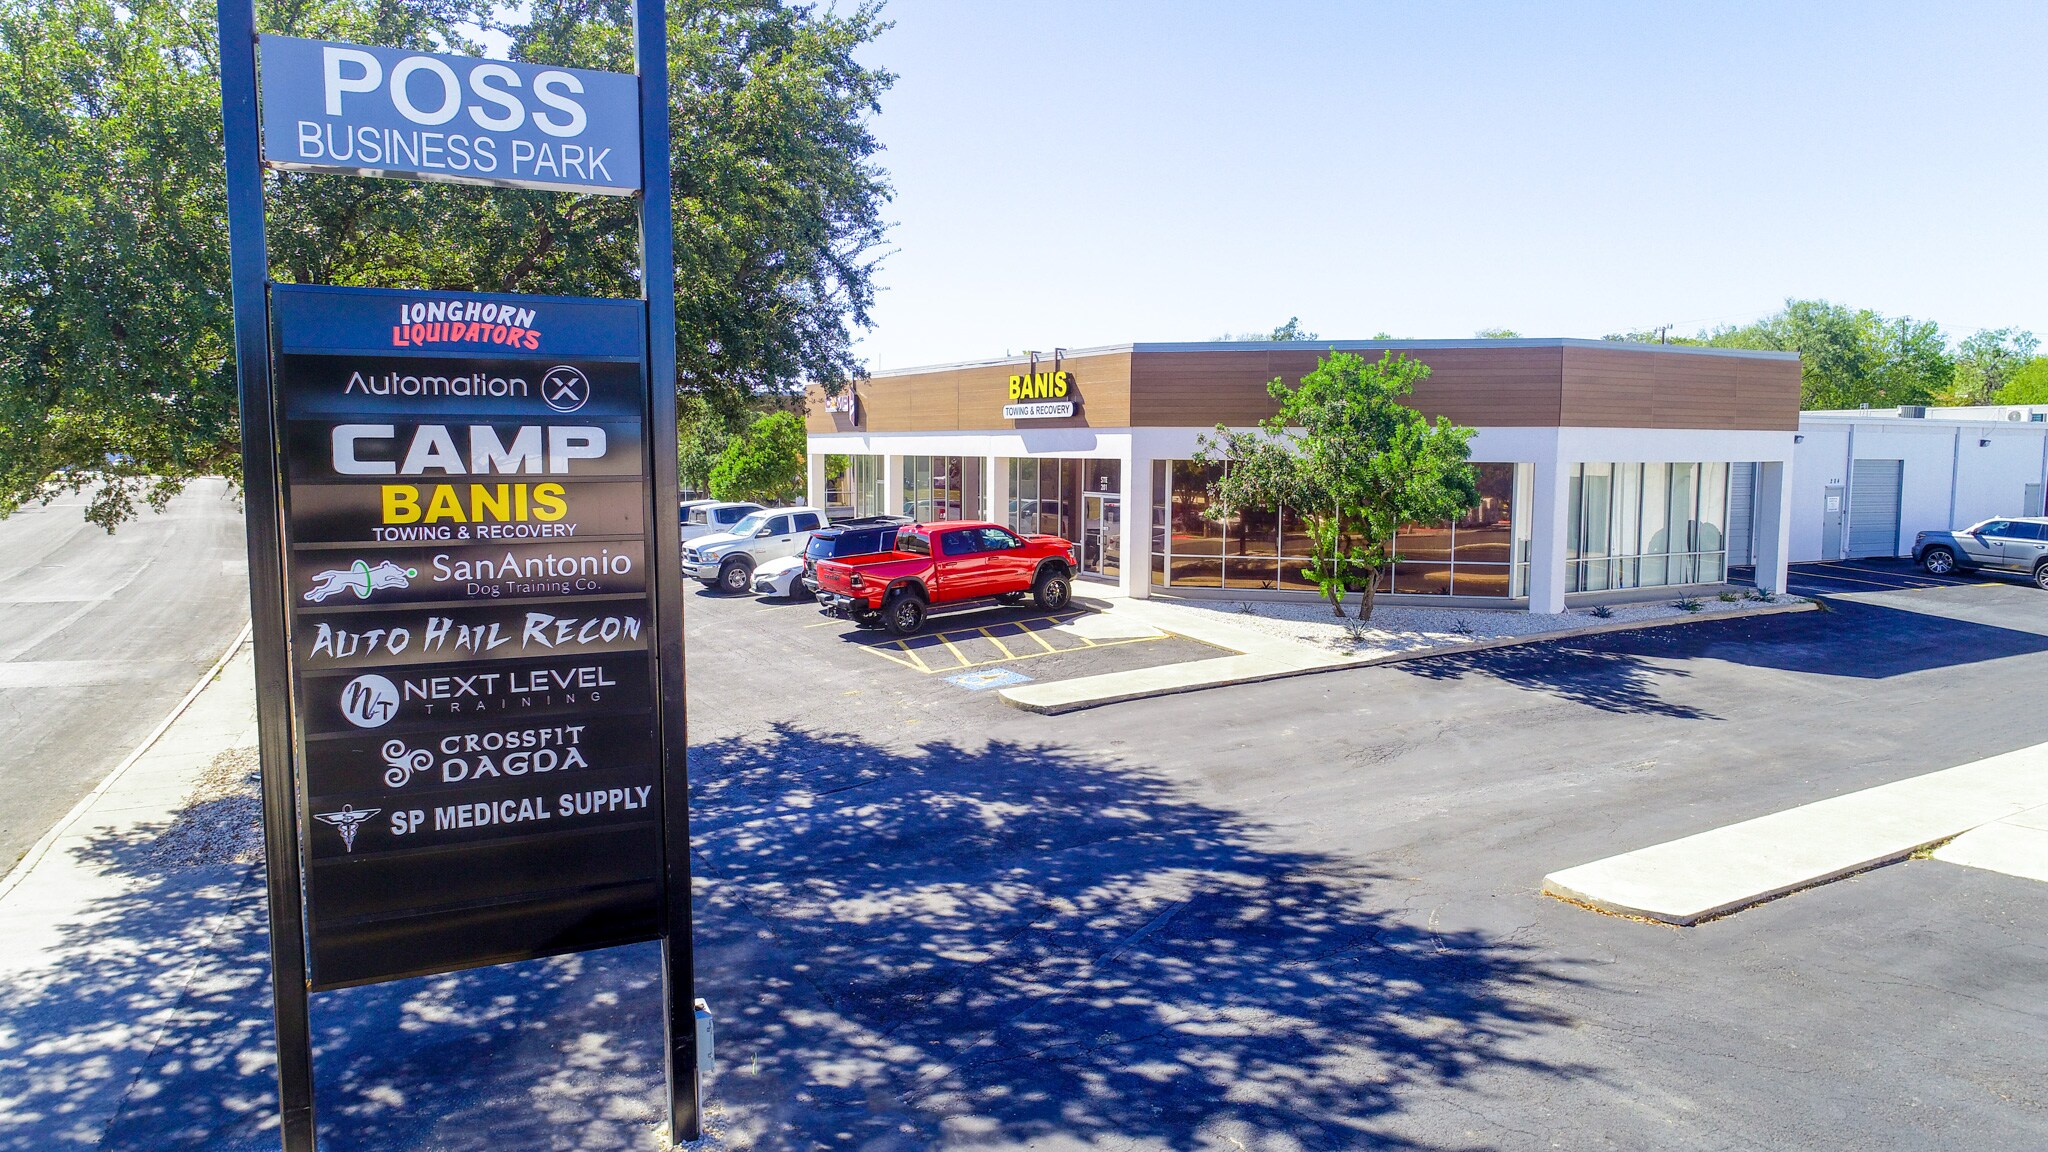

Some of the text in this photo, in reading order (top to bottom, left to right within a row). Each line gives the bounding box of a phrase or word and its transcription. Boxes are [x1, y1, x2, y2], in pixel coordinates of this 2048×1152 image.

[323, 46, 587, 138] POSS
[297, 121, 612, 182] BUSINESS PARK
[401, 301, 536, 329] LONGHORN
[392, 321, 542, 350] LIQUIDATORS
[344, 370, 527, 398] Automation
[1008, 371, 1068, 400] BANIS
[1005, 404, 1070, 416] TOWING & RECOVERY
[331, 424, 607, 475] CAMP
[381, 482, 568, 525] BANIS
[372, 523, 578, 542] TOWING & RECOVERY
[432, 548, 632, 582] SanAntonio
[466, 577, 601, 599] Dog Training Co.
[403, 666, 616, 701] NEXT LEVEL
[425, 693, 601, 714] TRAINING
[439, 724, 586, 755] CROSSFIT
[441, 747, 588, 784] DAGDA
[390, 785, 652, 836] SP MEDICAL SUPPLY
